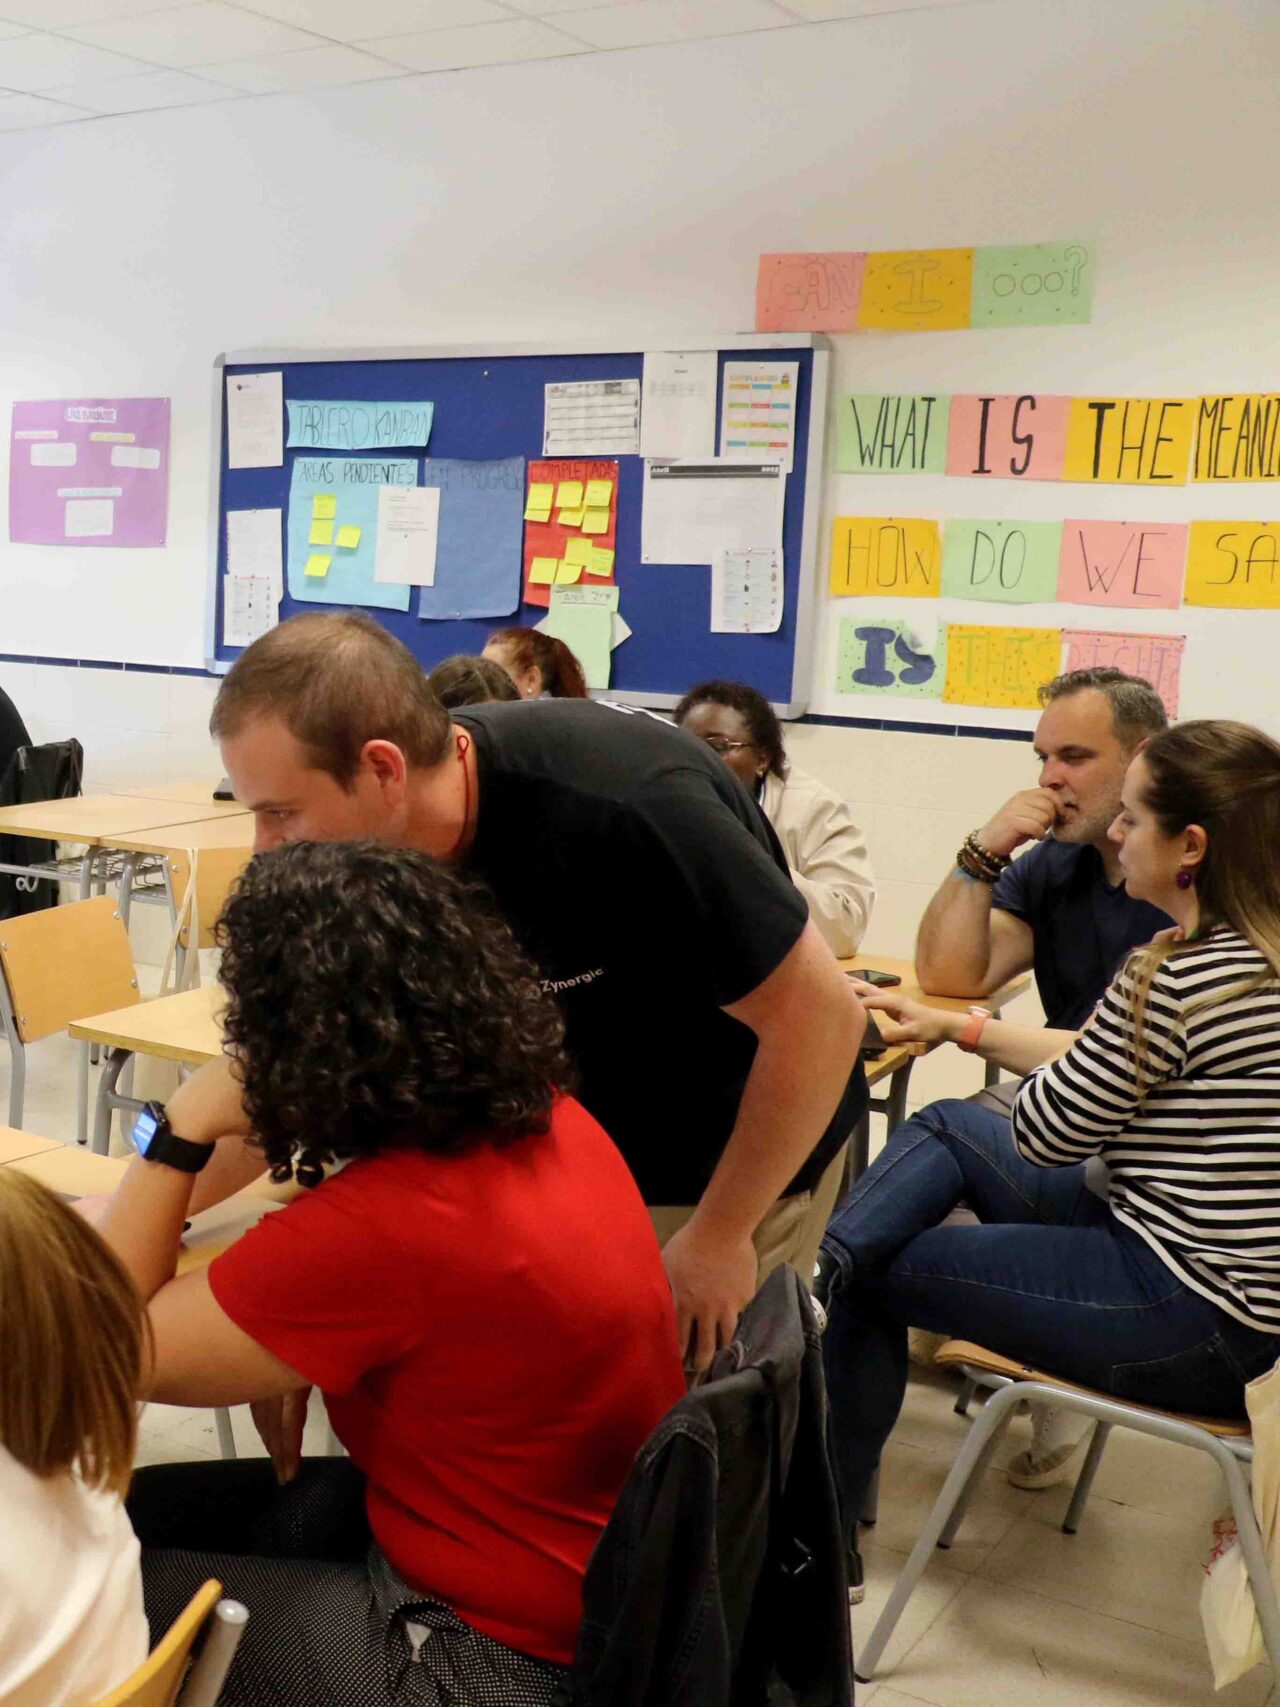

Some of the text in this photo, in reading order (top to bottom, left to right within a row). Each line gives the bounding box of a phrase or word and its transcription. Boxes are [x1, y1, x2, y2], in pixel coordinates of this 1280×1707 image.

[769, 254, 864, 312] CAN
[892, 259, 943, 314] I
[296, 405, 370, 447] TABLERO
[851, 395, 1280, 479] WHAT IS THE MEANI
[344, 462, 417, 484] PENDIENTES
[531, 461, 617, 481] COMPLETADAS
[846, 525, 936, 587] HOW
[971, 530, 1026, 589] DO
[1079, 531, 1167, 597] WE
[852, 626, 936, 687] IS
[540, 968, 604, 993] Zynergic
